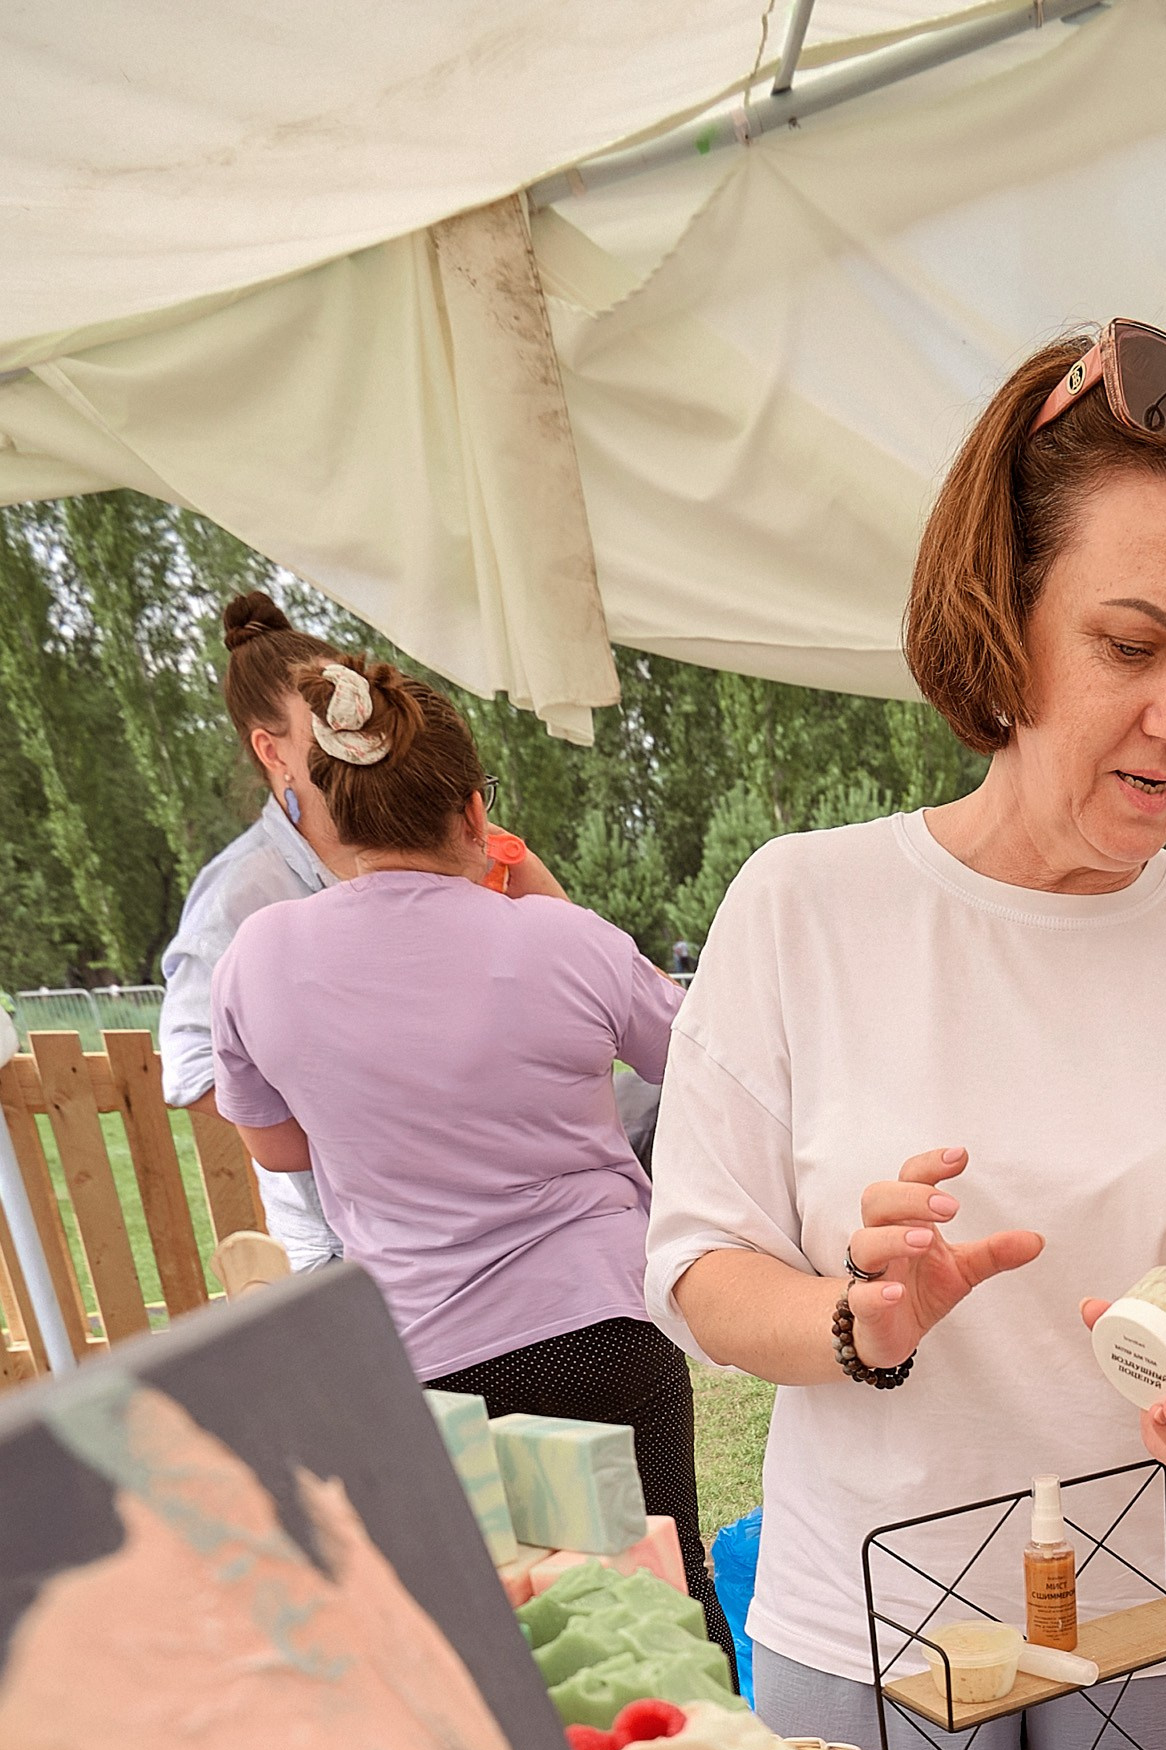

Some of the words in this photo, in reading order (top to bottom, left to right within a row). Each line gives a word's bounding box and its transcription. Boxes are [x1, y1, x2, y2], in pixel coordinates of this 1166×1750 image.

[1118, 1364, 1162, 1390] ПОЦЕЛУЙ
[1046, 1582, 1068, 1590] МИСТ
[1036, 1589, 1075, 1600] ШИММЕРО
